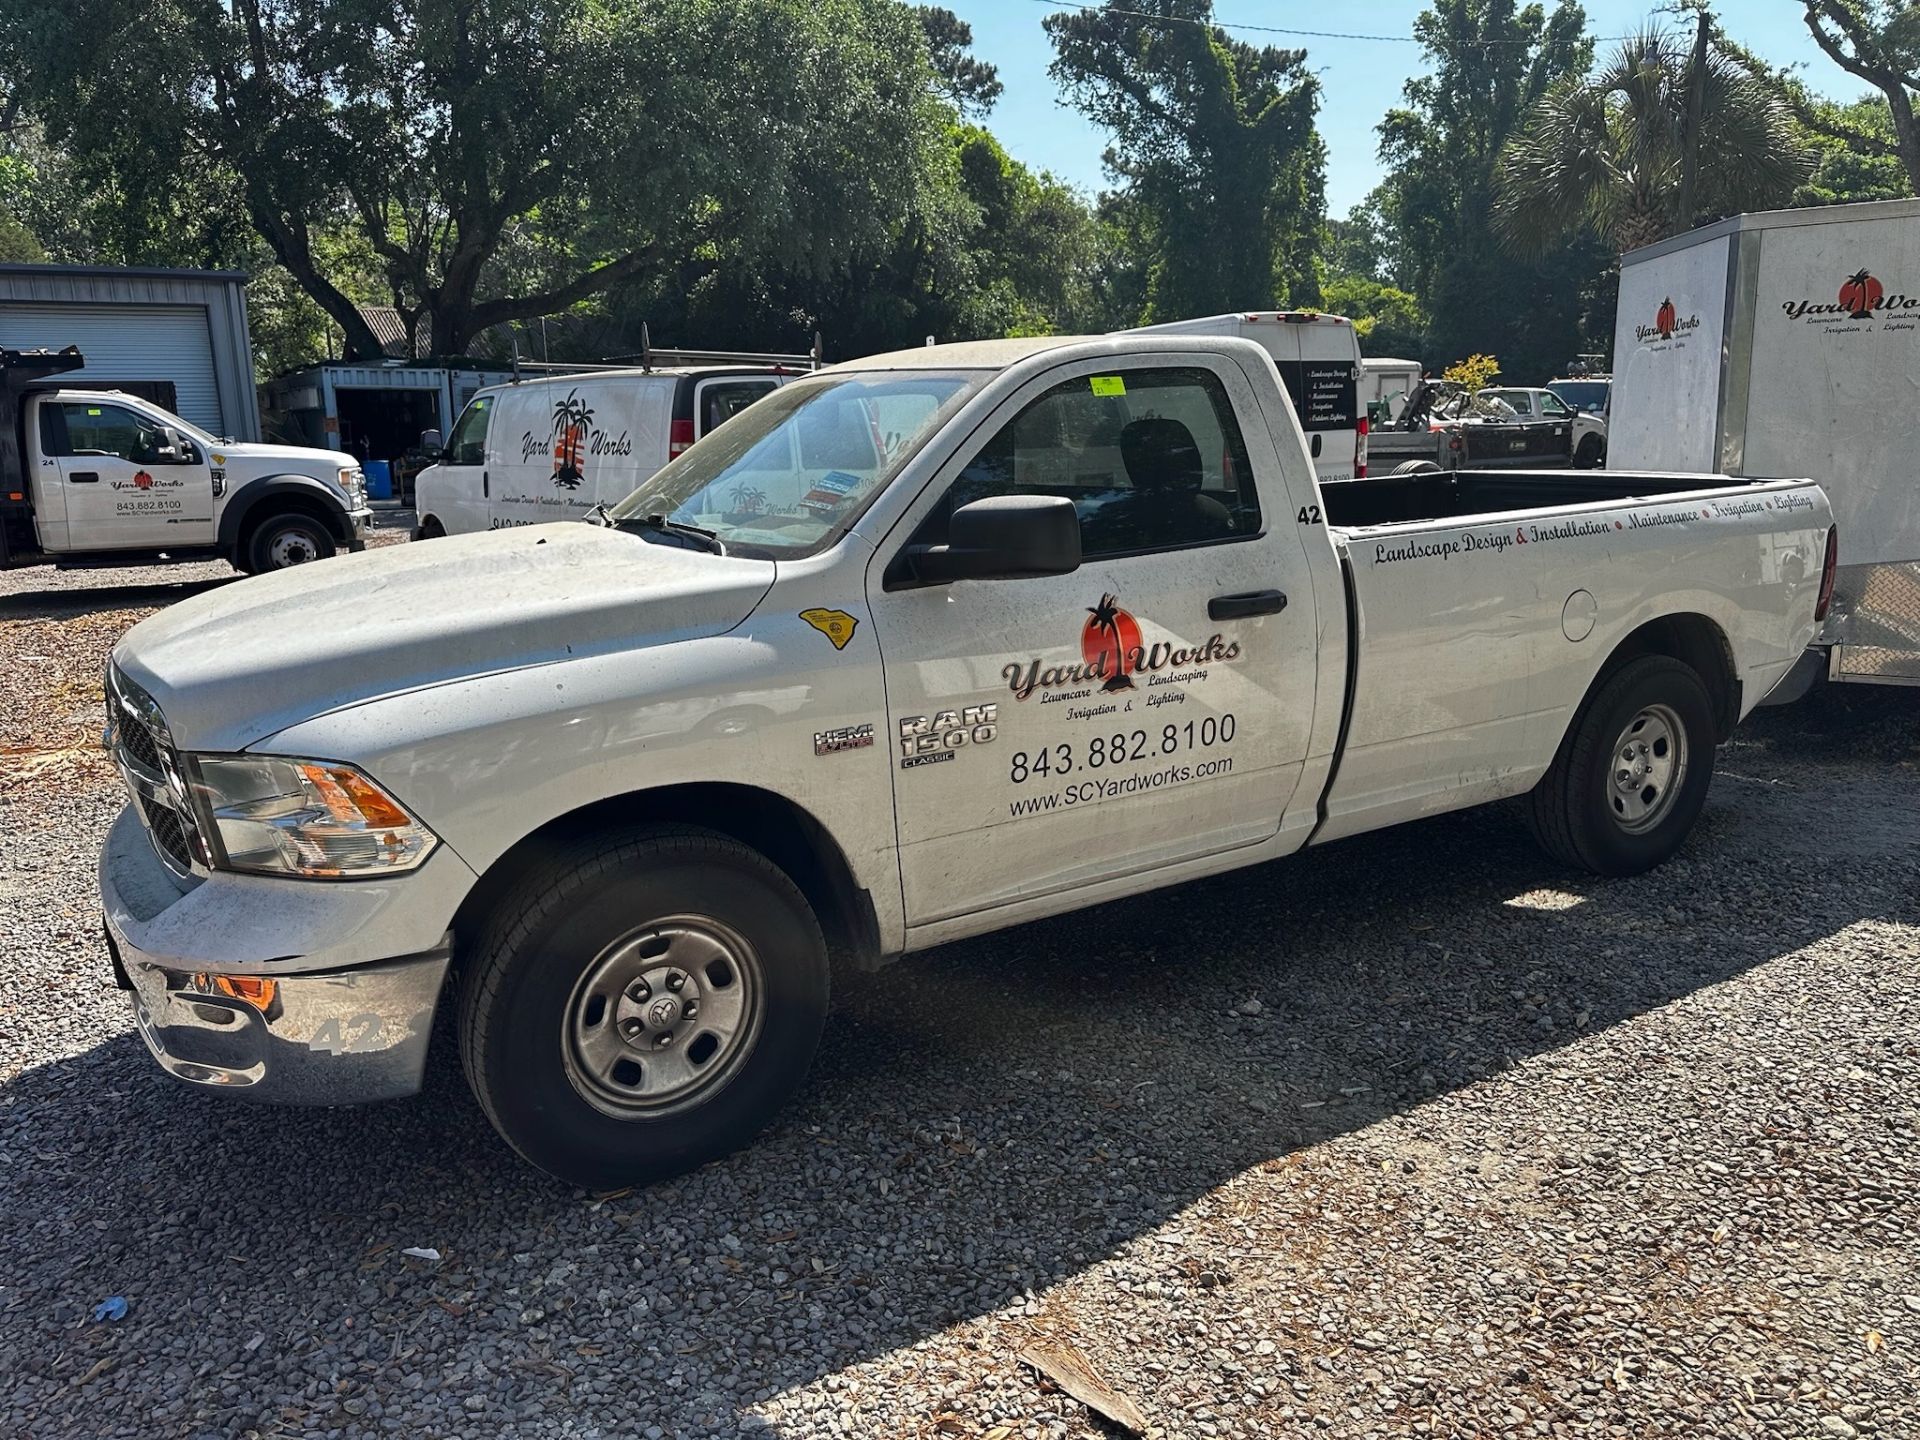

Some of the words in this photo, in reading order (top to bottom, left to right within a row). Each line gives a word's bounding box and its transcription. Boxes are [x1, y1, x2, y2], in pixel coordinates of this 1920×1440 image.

[1782, 297, 1856, 320] Yard
[1635, 322, 1664, 342] Yard
[1671, 314, 1700, 332] Works
[522, 430, 552, 464] Yard
[591, 429, 632, 456] Works
[149, 479, 184, 488] Works
[1297, 505, 1323, 525] 42
[1375, 541, 1461, 564] Landscape
[1462, 531, 1513, 552] Design
[1516, 527, 1527, 544] &
[1531, 520, 1611, 543] Installation
[1628, 511, 1700, 530] Maintenance
[1712, 502, 1764, 521] Irrigation
[1775, 495, 1814, 510] Lighting
[1002, 650, 1111, 701] Yard
[1128, 634, 1241, 674] Works
[1041, 688, 1091, 704] Lawncare
[1148, 668, 1208, 687] Landscaping
[900, 703, 997, 737] RAM
[1066, 704, 1117, 720] Irrigation
[1124, 700, 1133, 712] &
[1146, 691, 1185, 708] Lighting
[814, 724, 874, 745] HEMI
[901, 724, 997, 757] 1500
[1010, 713, 1236, 784] 843.882.8100
[903, 751, 954, 768] CLASSIC
[1010, 757, 1233, 816] www.SCYardworks.com
[309, 1013, 387, 1056] 42
